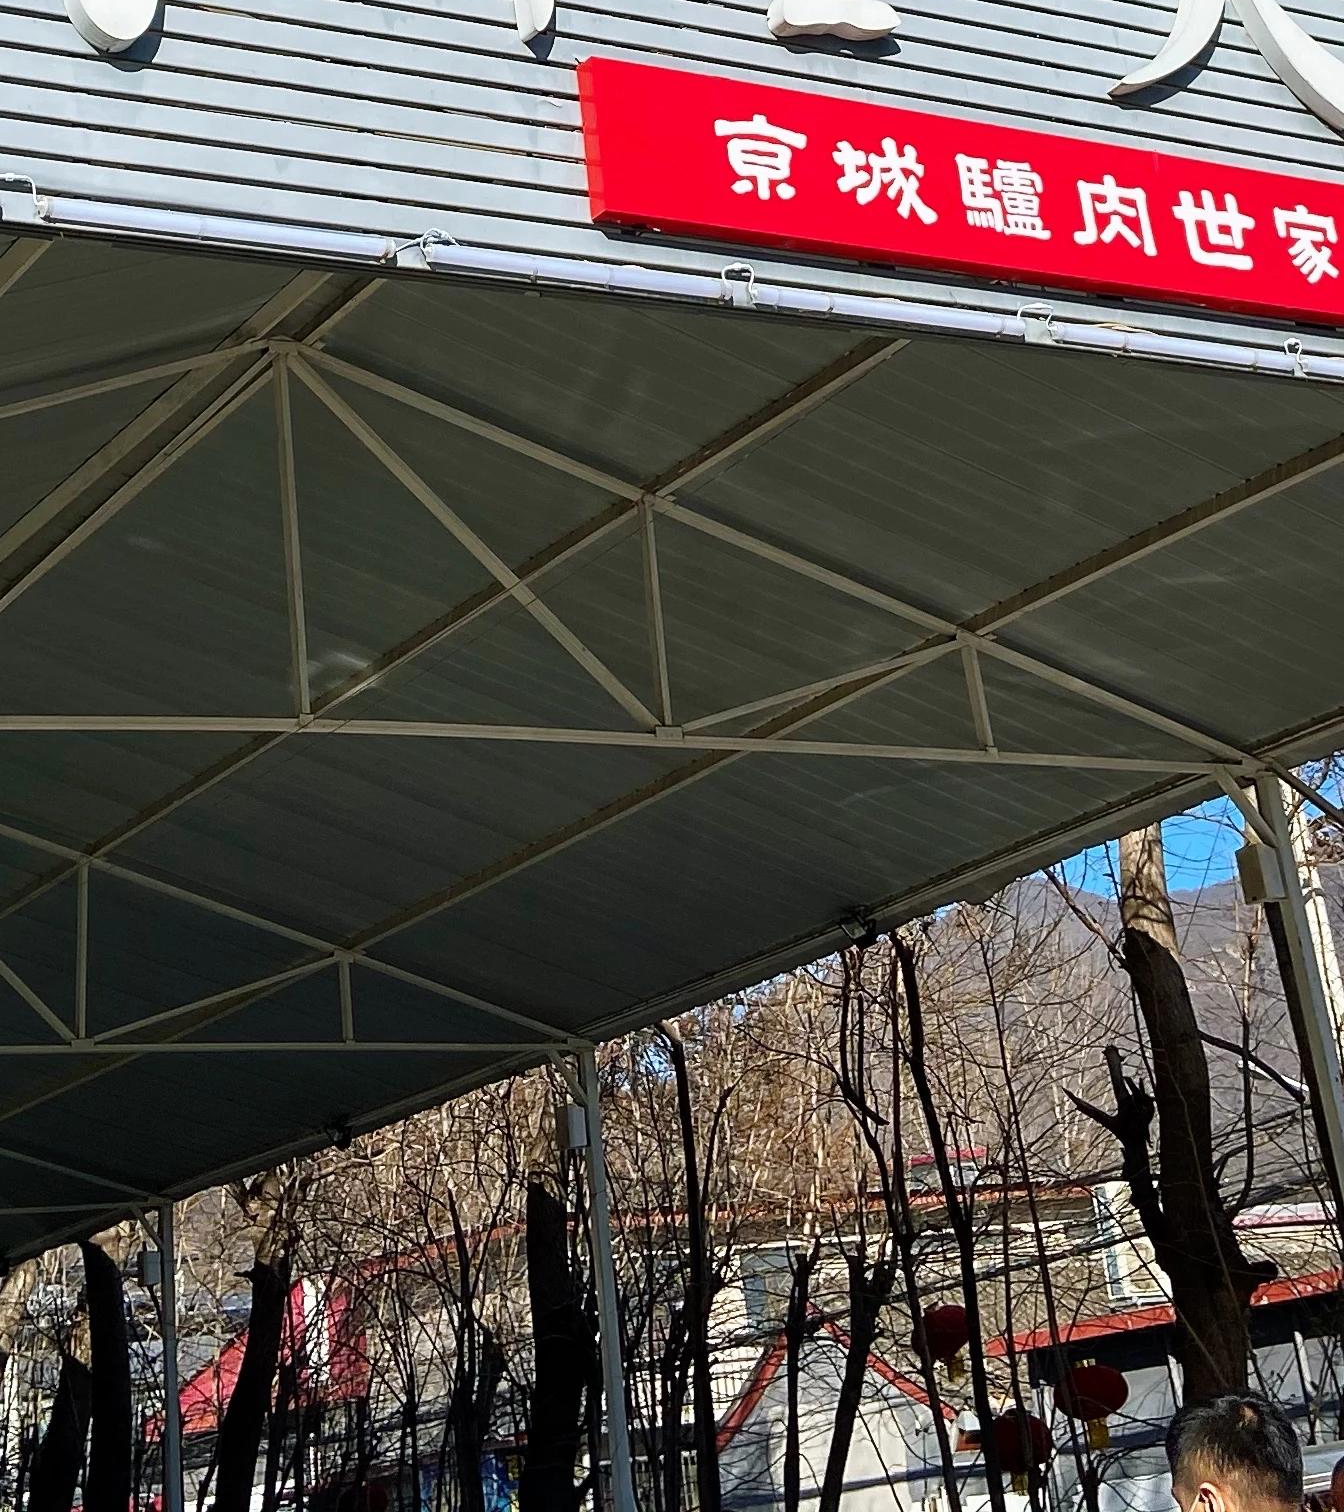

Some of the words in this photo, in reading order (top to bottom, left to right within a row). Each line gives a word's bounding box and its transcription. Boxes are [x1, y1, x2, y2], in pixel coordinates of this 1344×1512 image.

[714, 114, 1340, 284] 京城驢肉世家
